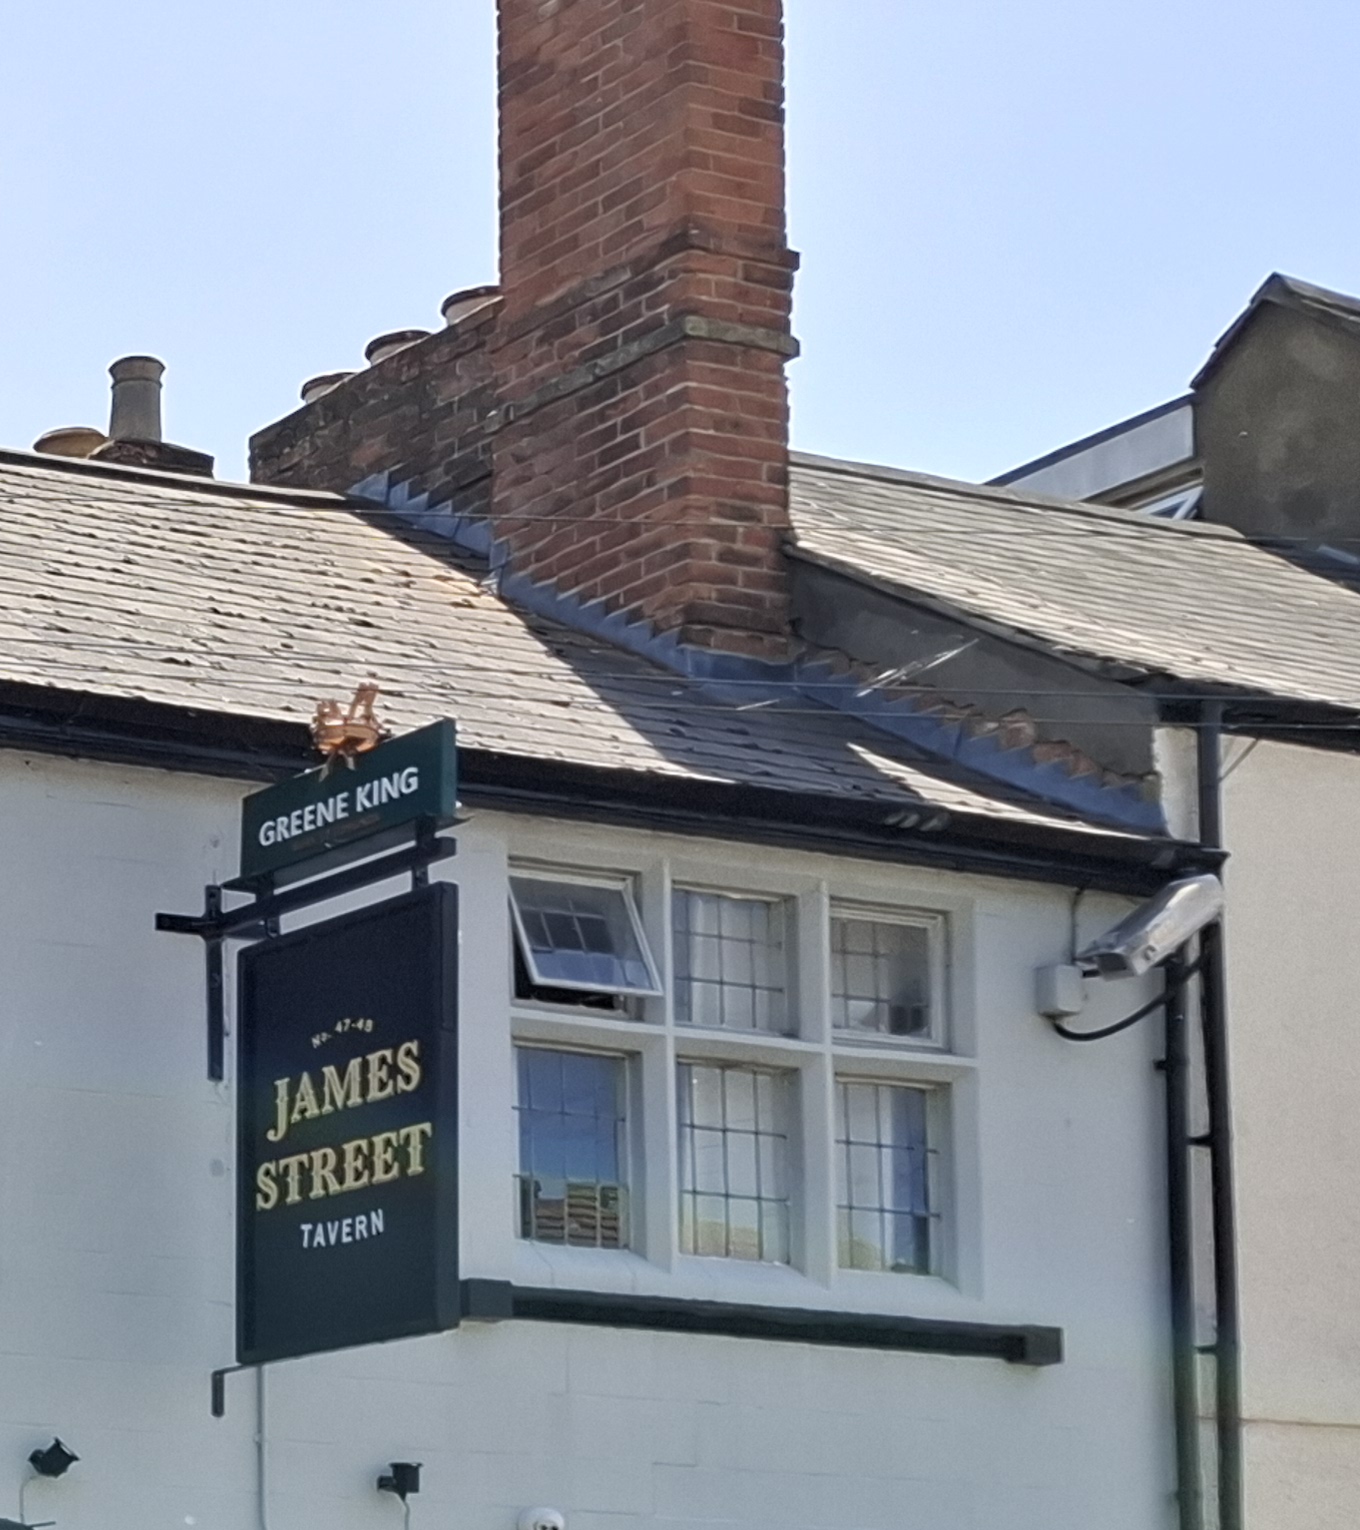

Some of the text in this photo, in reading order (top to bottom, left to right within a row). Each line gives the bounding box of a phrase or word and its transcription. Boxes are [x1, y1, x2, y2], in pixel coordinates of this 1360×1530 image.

[259, 791, 350, 846] GREENE
[355, 767, 419, 812] KING
[266, 1039, 421, 1142] JAMES
[256, 1121, 433, 1211] STREET
[300, 1208, 385, 1248] TAVERN
